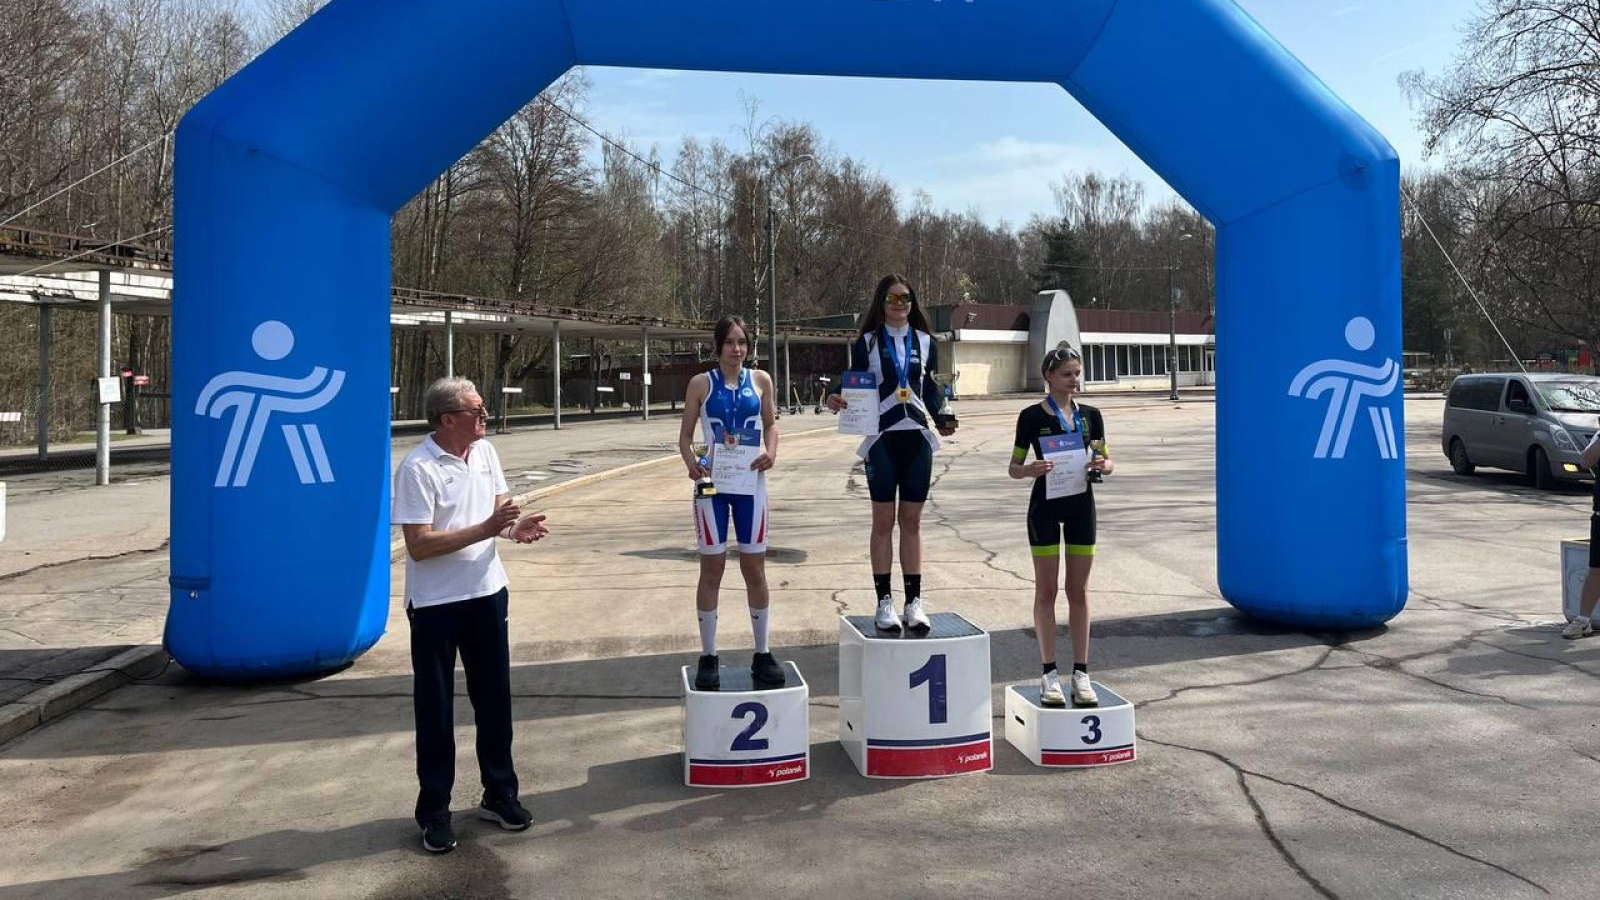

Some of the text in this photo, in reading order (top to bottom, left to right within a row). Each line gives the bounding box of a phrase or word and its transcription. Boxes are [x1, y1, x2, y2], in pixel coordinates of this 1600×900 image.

[910, 654, 947, 724] 1
[730, 702, 769, 751] 2
[1081, 715, 1102, 745] 3
